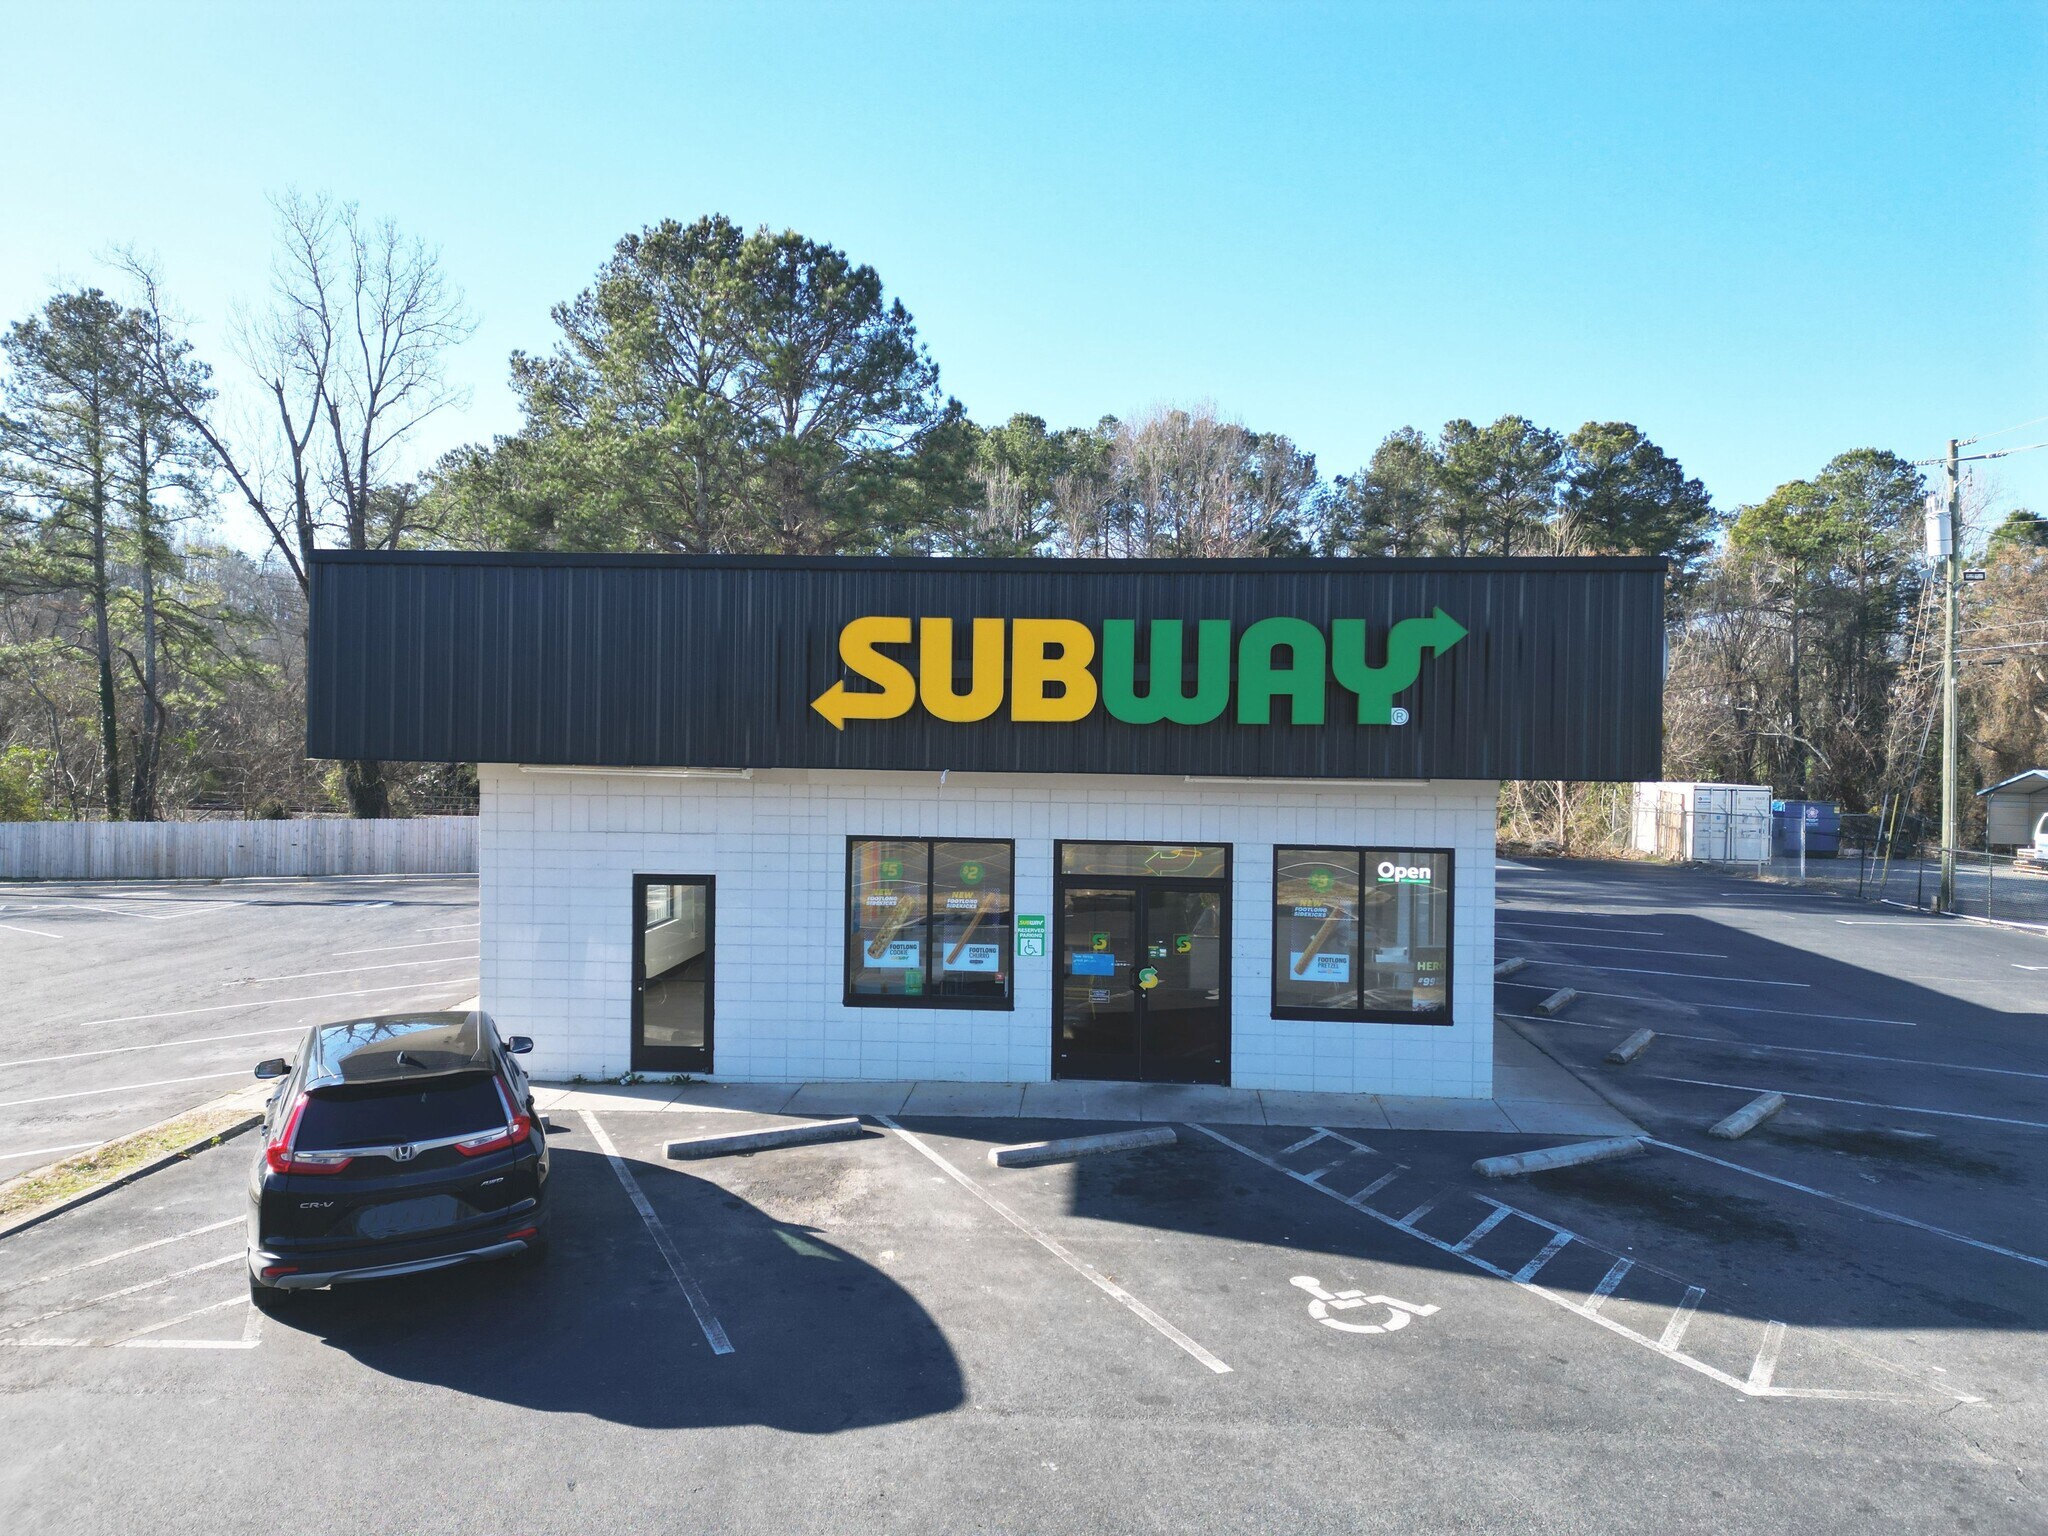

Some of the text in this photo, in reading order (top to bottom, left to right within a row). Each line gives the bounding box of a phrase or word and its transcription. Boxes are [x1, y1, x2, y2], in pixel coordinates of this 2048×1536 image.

[811, 606, 1468, 731] SUBWAY
[962, 865, 978, 879] $2
[1378, 861, 1431, 882] Open
